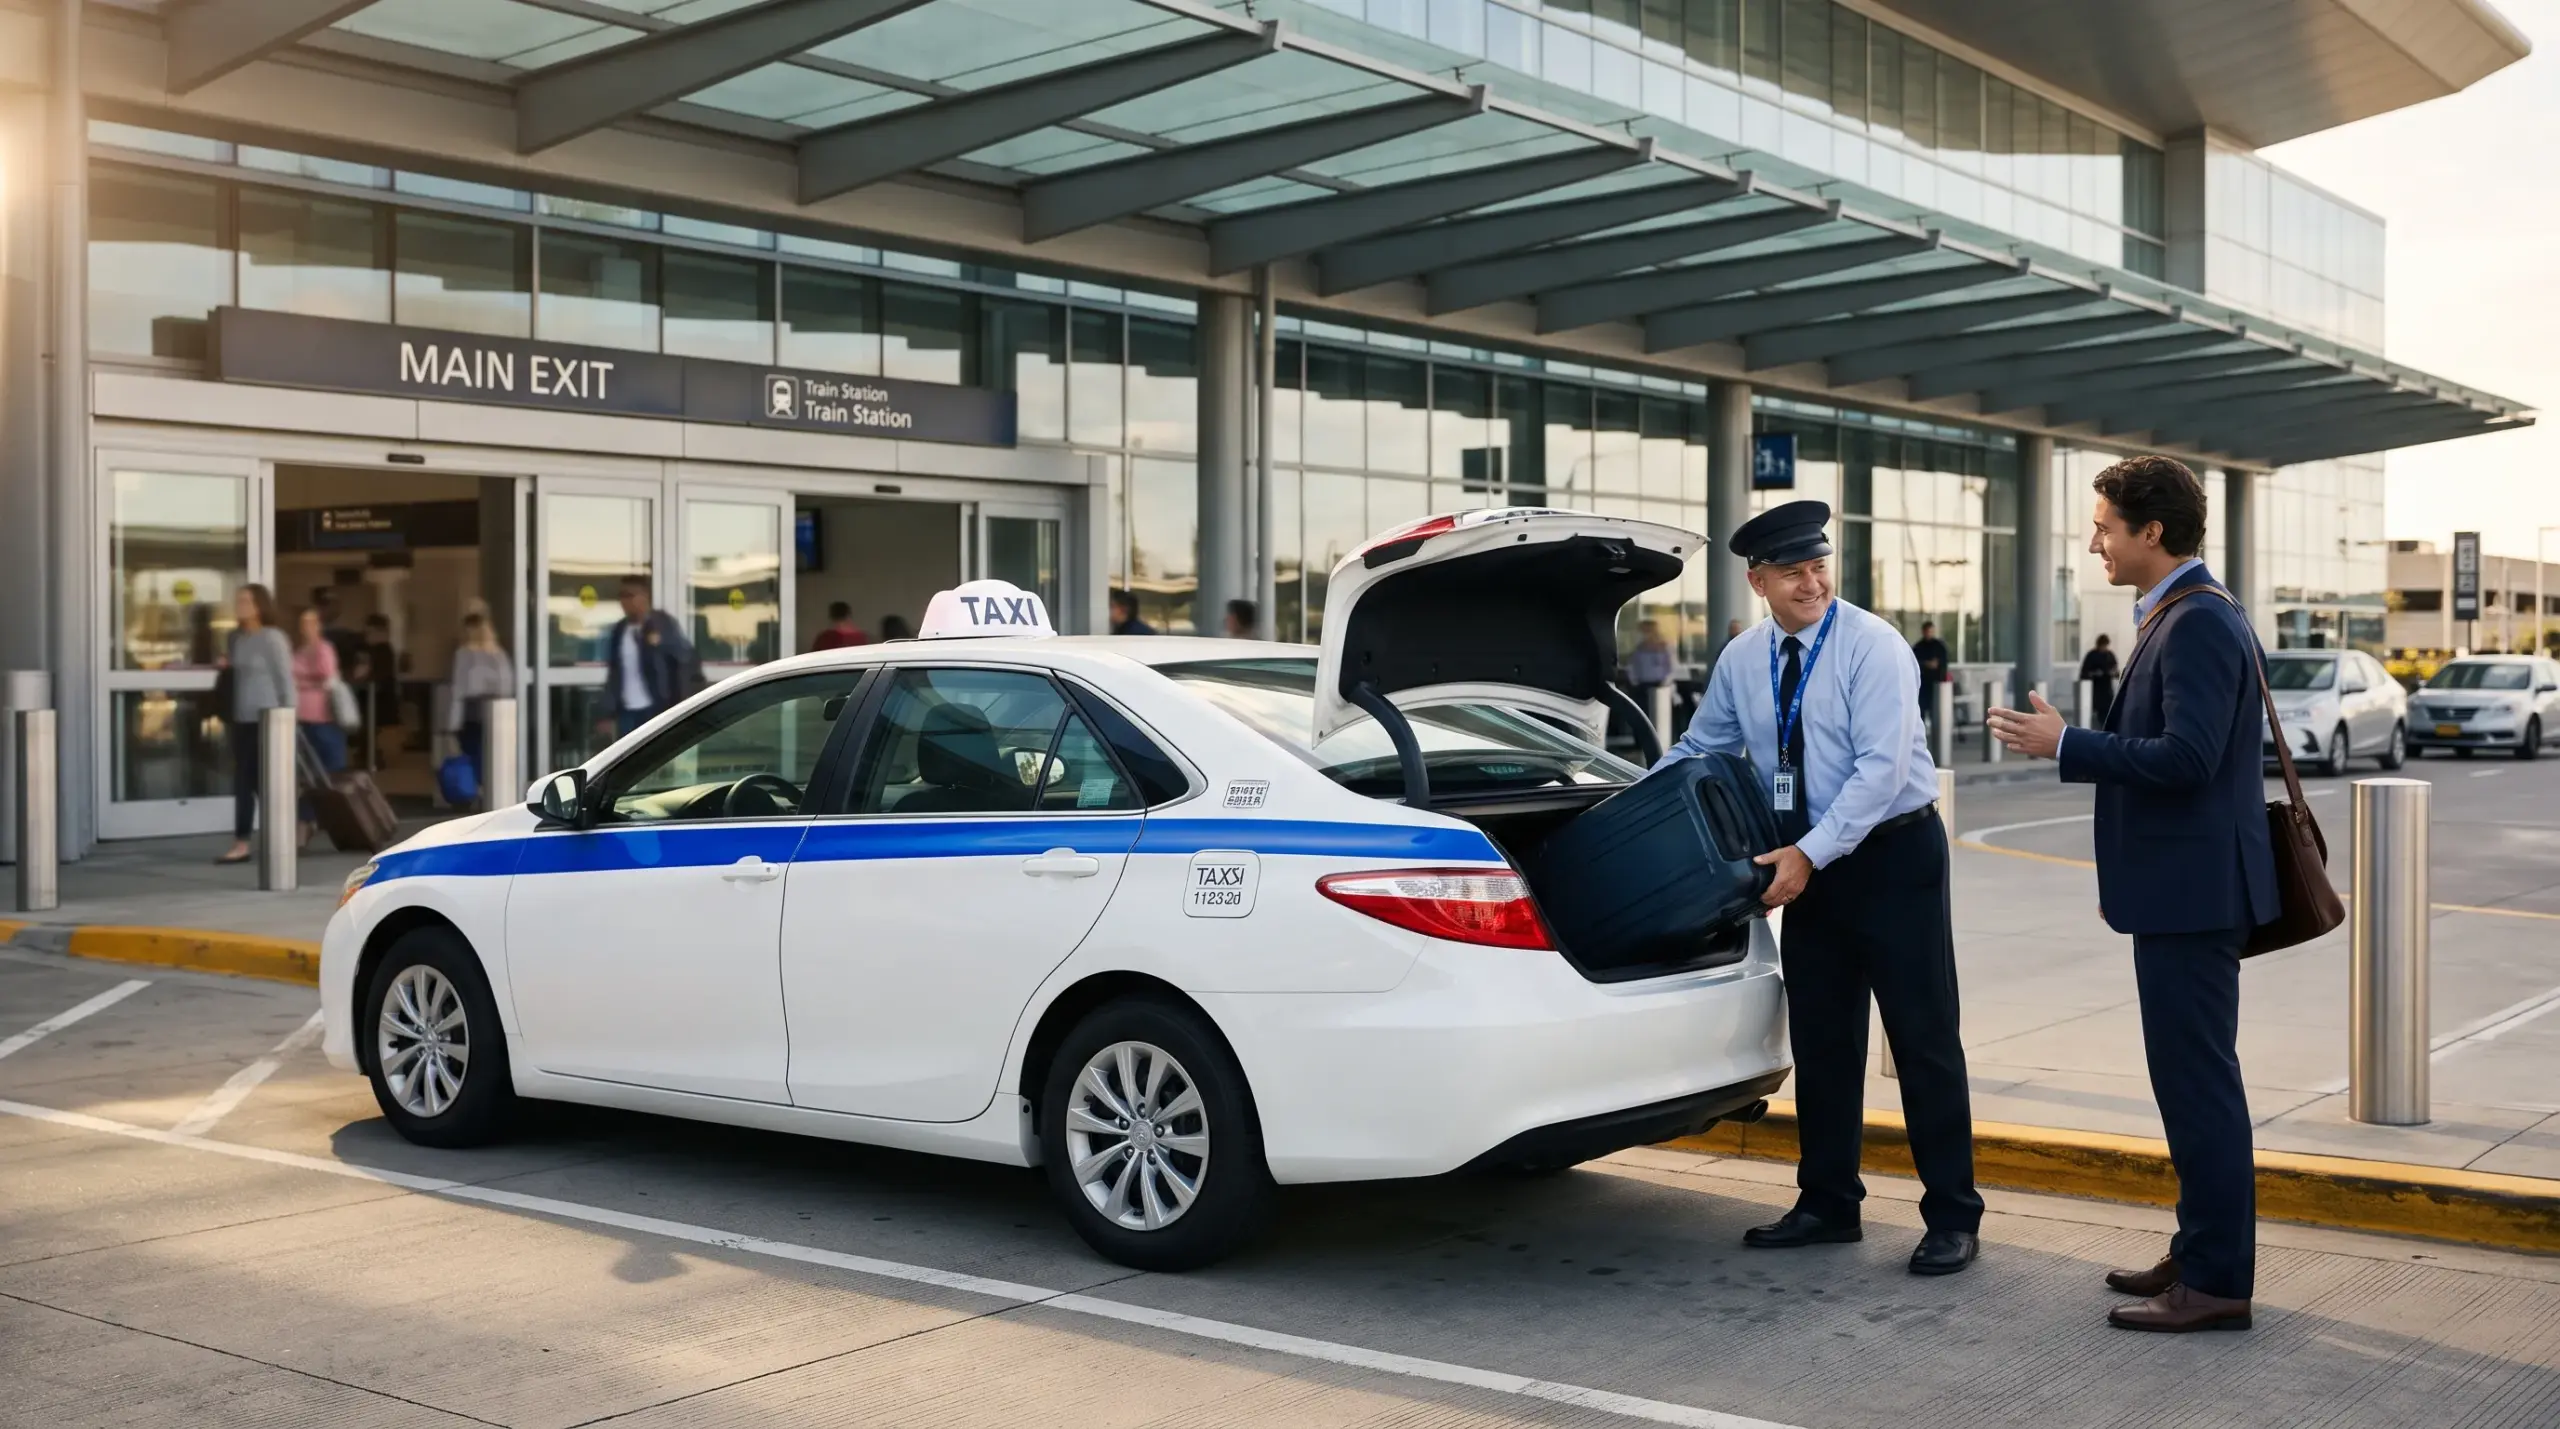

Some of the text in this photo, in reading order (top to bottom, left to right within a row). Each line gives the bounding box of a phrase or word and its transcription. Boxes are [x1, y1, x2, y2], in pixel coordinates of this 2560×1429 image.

[401, 341, 614, 399] MAIN EXIT
[804, 379, 888, 402] Train Station
[804, 399, 912, 429] Train Station
[960, 596, 1039, 626] TAXI
